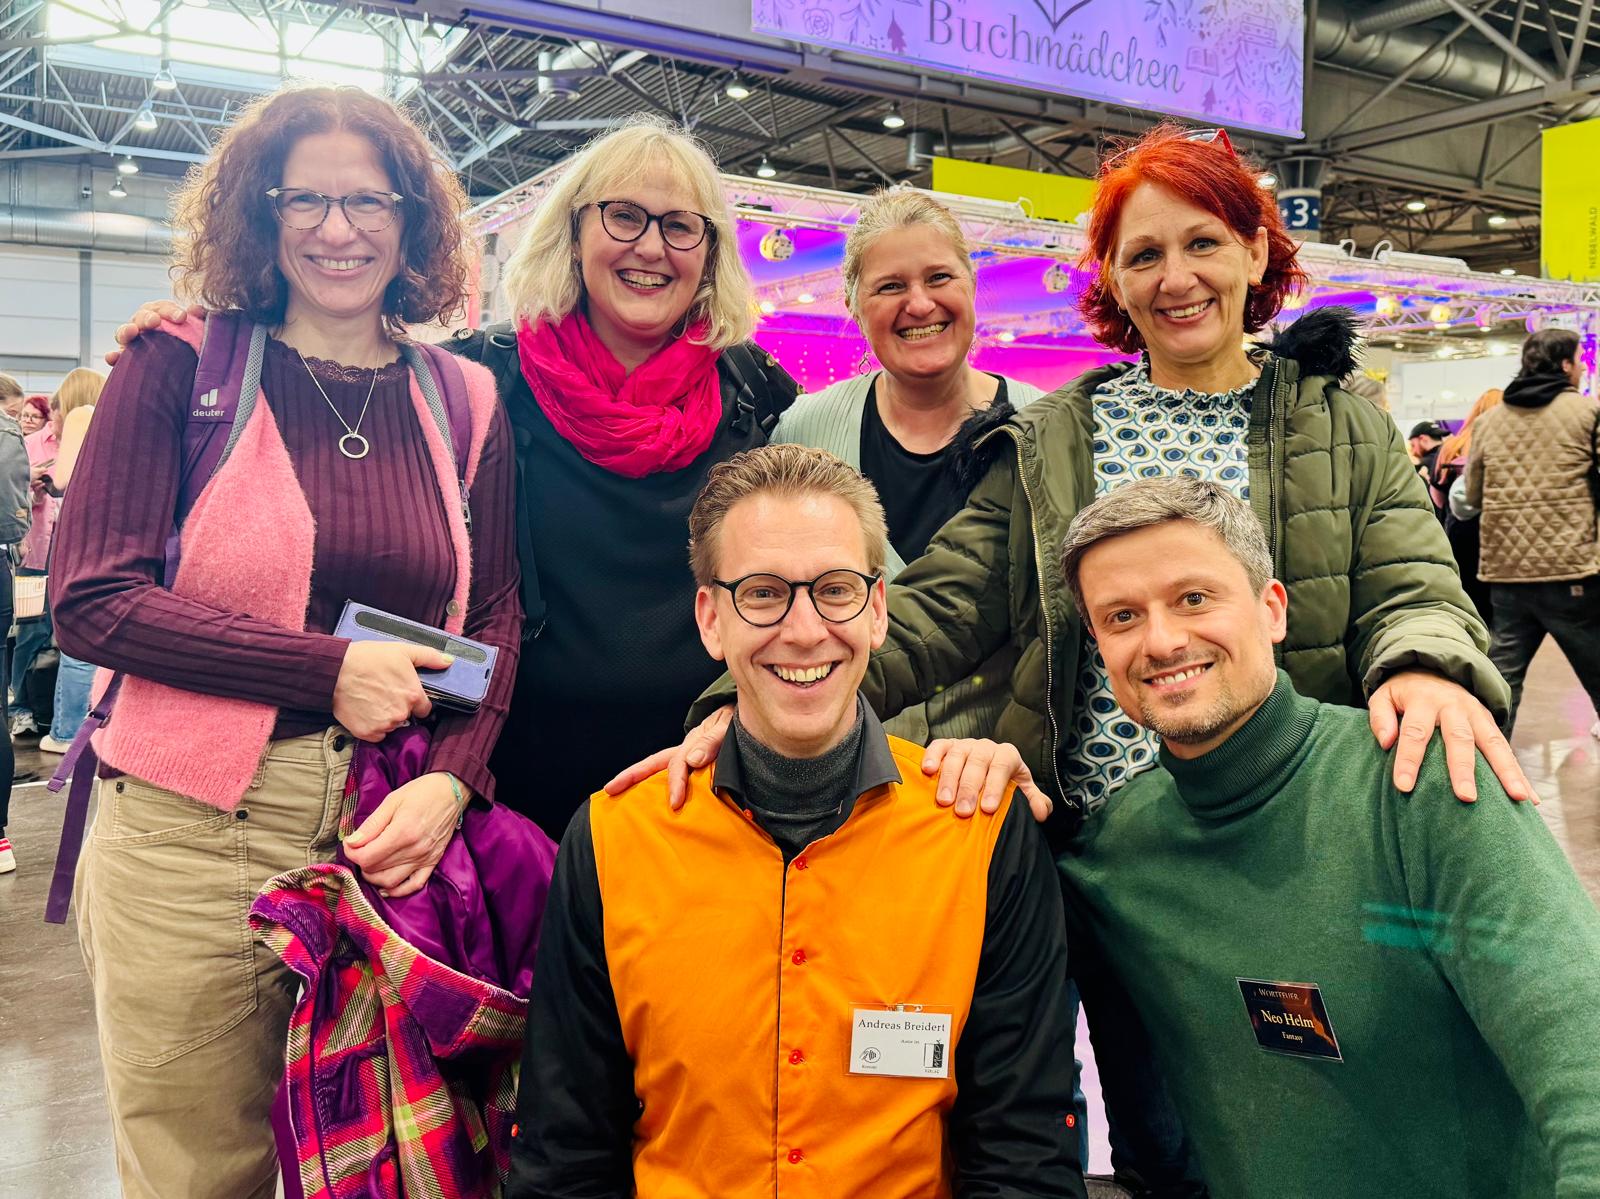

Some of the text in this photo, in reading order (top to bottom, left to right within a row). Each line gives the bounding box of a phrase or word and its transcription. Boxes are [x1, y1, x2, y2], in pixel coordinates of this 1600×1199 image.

[925, 0, 1185, 94] Buchmädchen
[1291, 198, 1309, 227] 3
[192, 409, 225, 417] deuter
[858, 1019, 945, 1032] Andreas Breidert
[1260, 1009, 1315, 1029] Neo Helm
